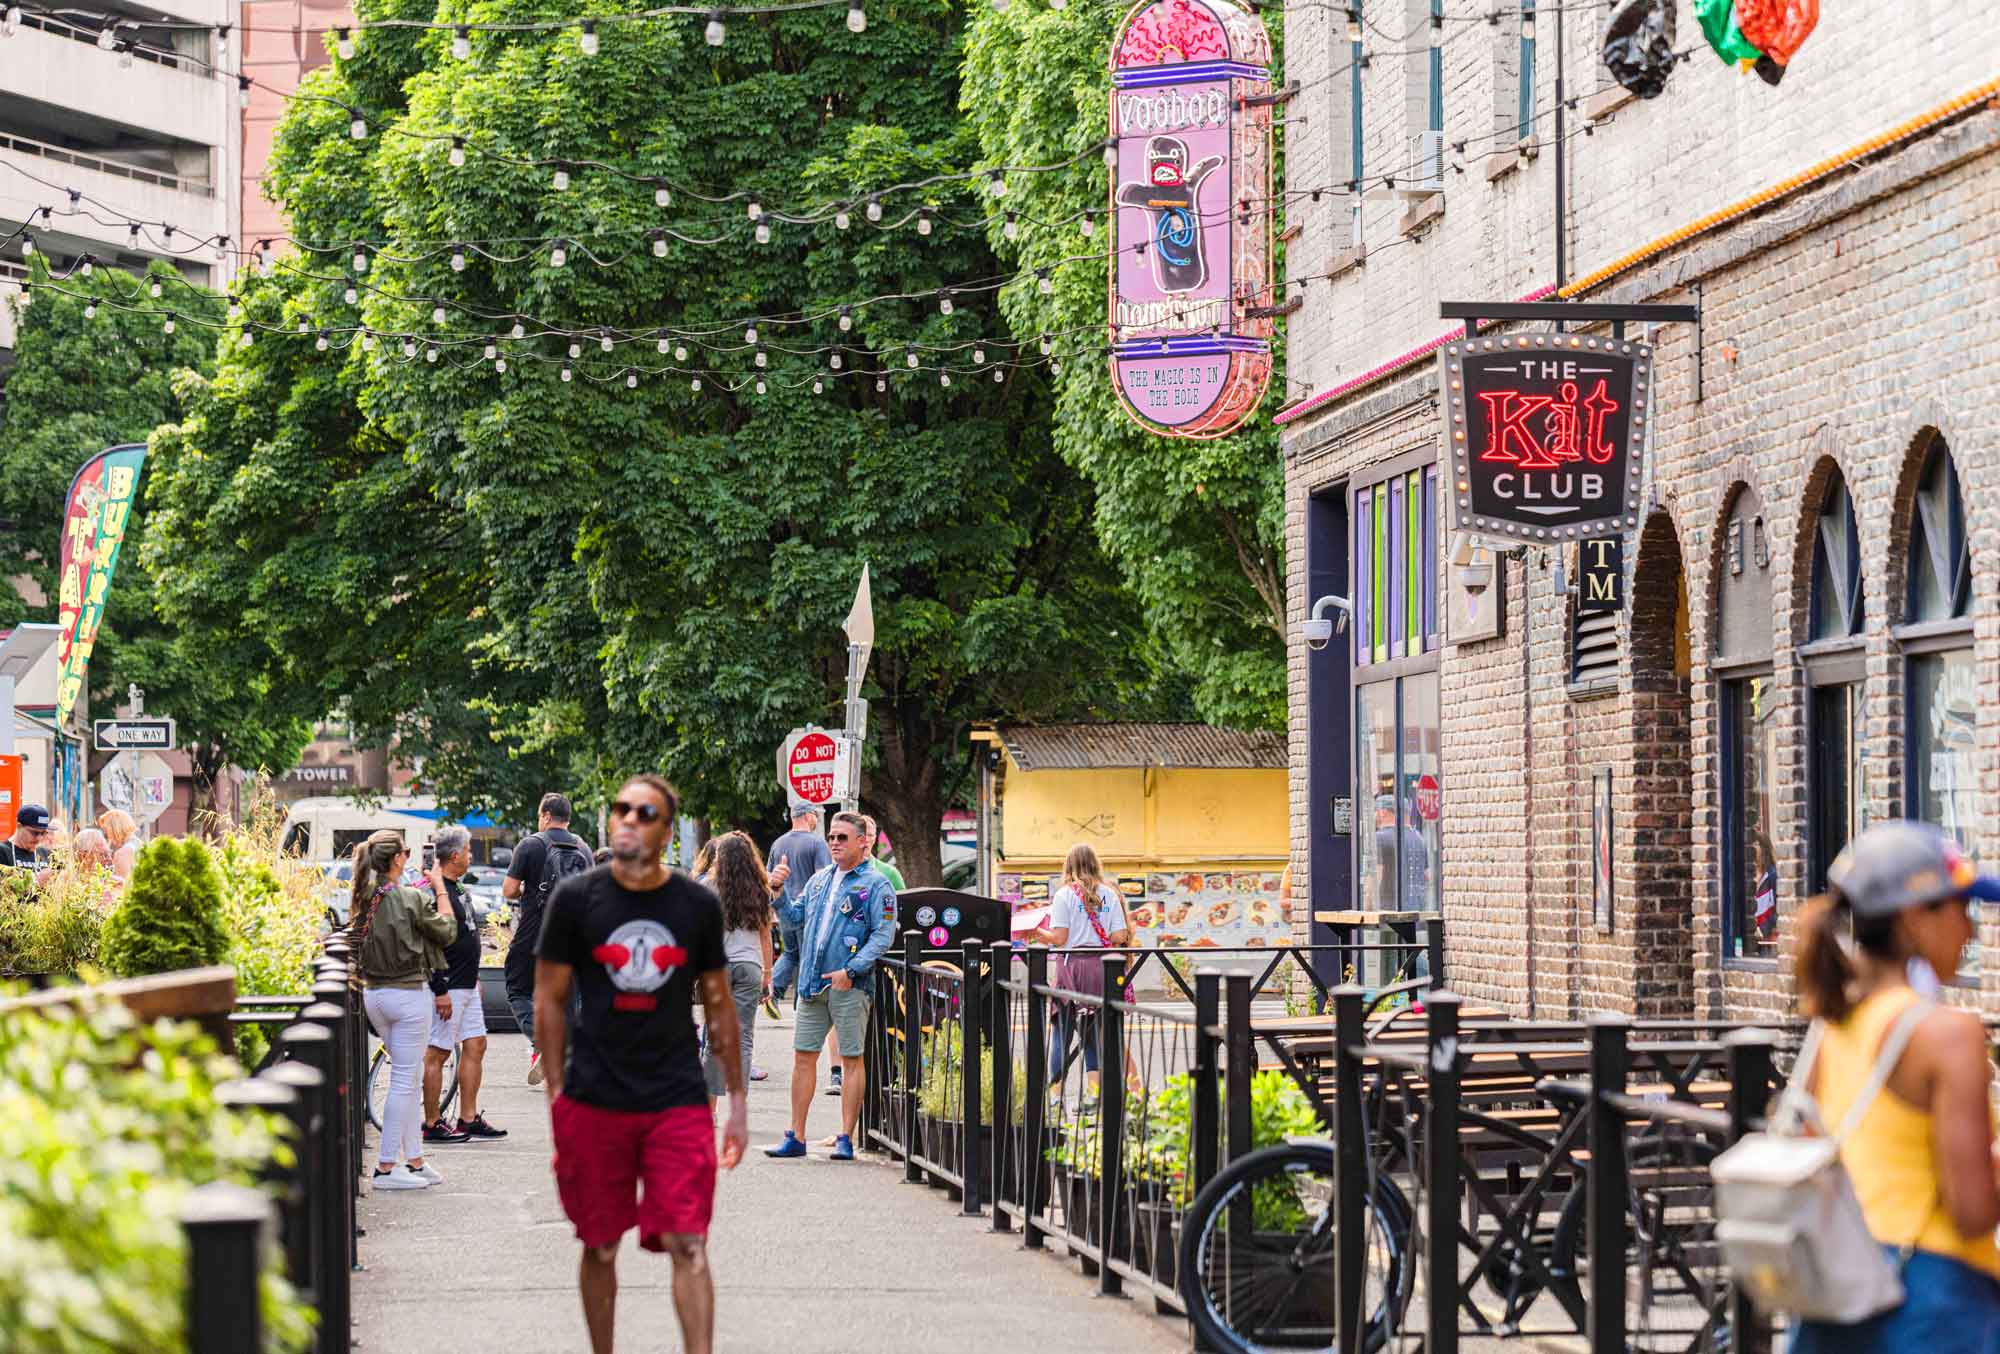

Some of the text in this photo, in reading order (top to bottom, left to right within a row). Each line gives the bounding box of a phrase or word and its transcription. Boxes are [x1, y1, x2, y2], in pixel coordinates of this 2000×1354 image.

[1129, 366, 1218, 387] THE MAGIC IS IN
[1520, 361, 1577, 380] THE
[1149, 388, 1199, 406] THE HOLE
[1492, 473, 1604, 499] CLUB
[118, 729, 162, 741] ONE WAY
[796, 744, 834, 760] DO NOT
[295, 767, 348, 781] TOWER
[801, 777, 833, 791] ENTER
